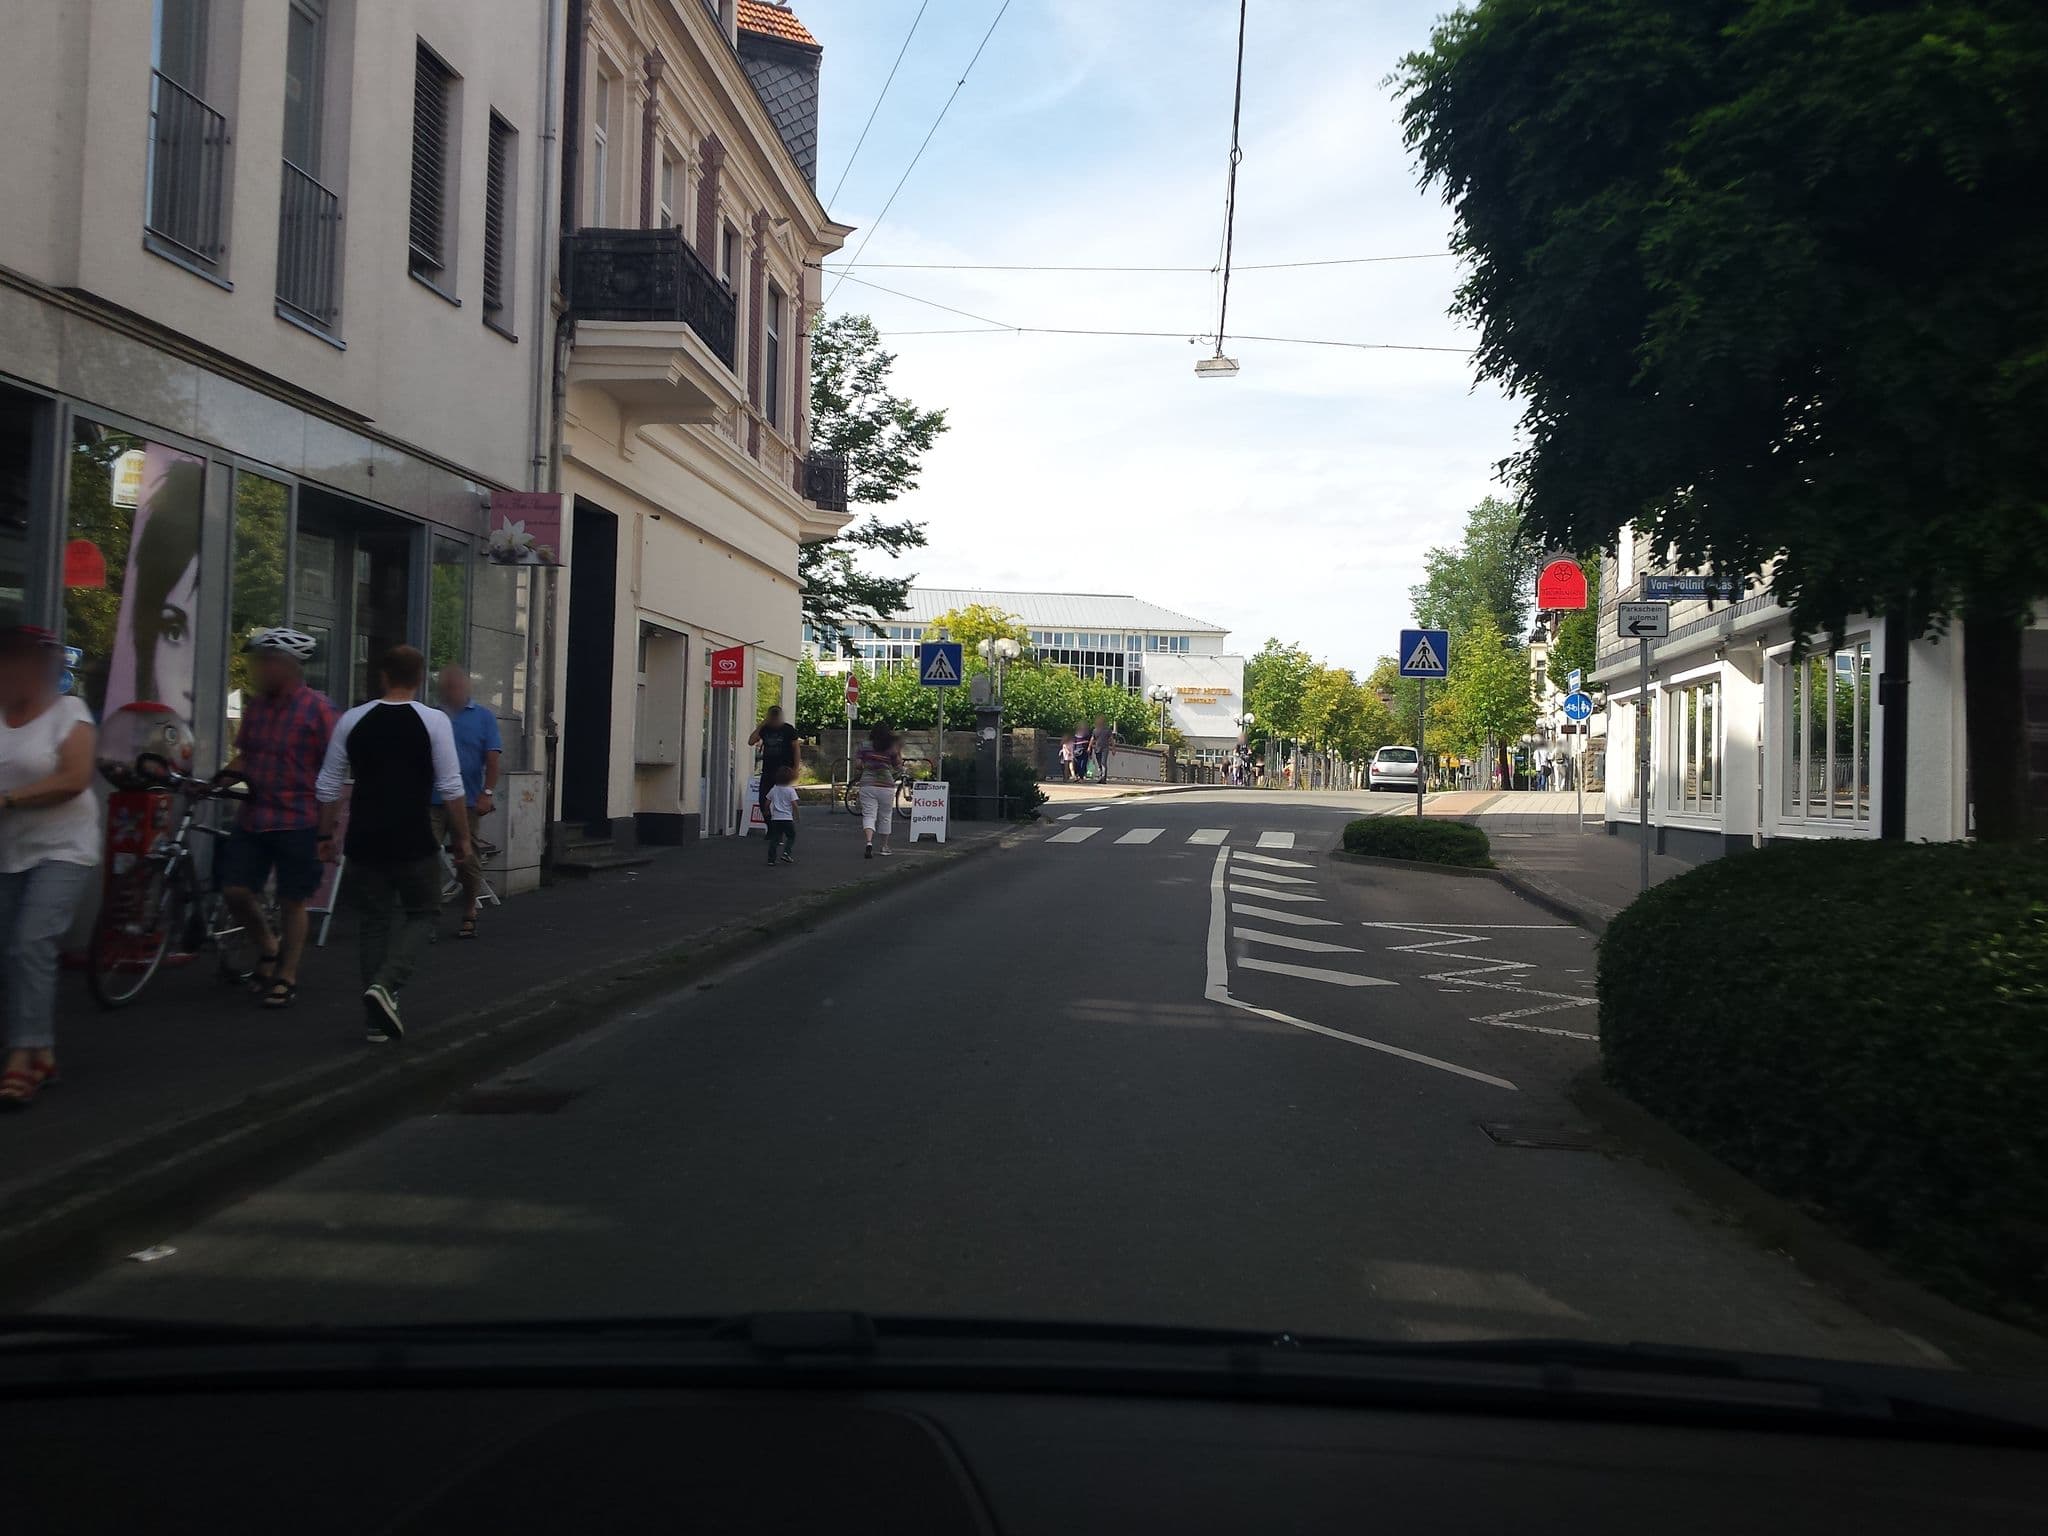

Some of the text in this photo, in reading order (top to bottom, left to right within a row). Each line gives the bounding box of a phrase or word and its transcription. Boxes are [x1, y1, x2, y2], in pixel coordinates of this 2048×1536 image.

[1621, 605, 1665, 613] Parkschein-
[914, 798, 945, 807] Kiosk
[913, 815, 944, 823] geöffnet
